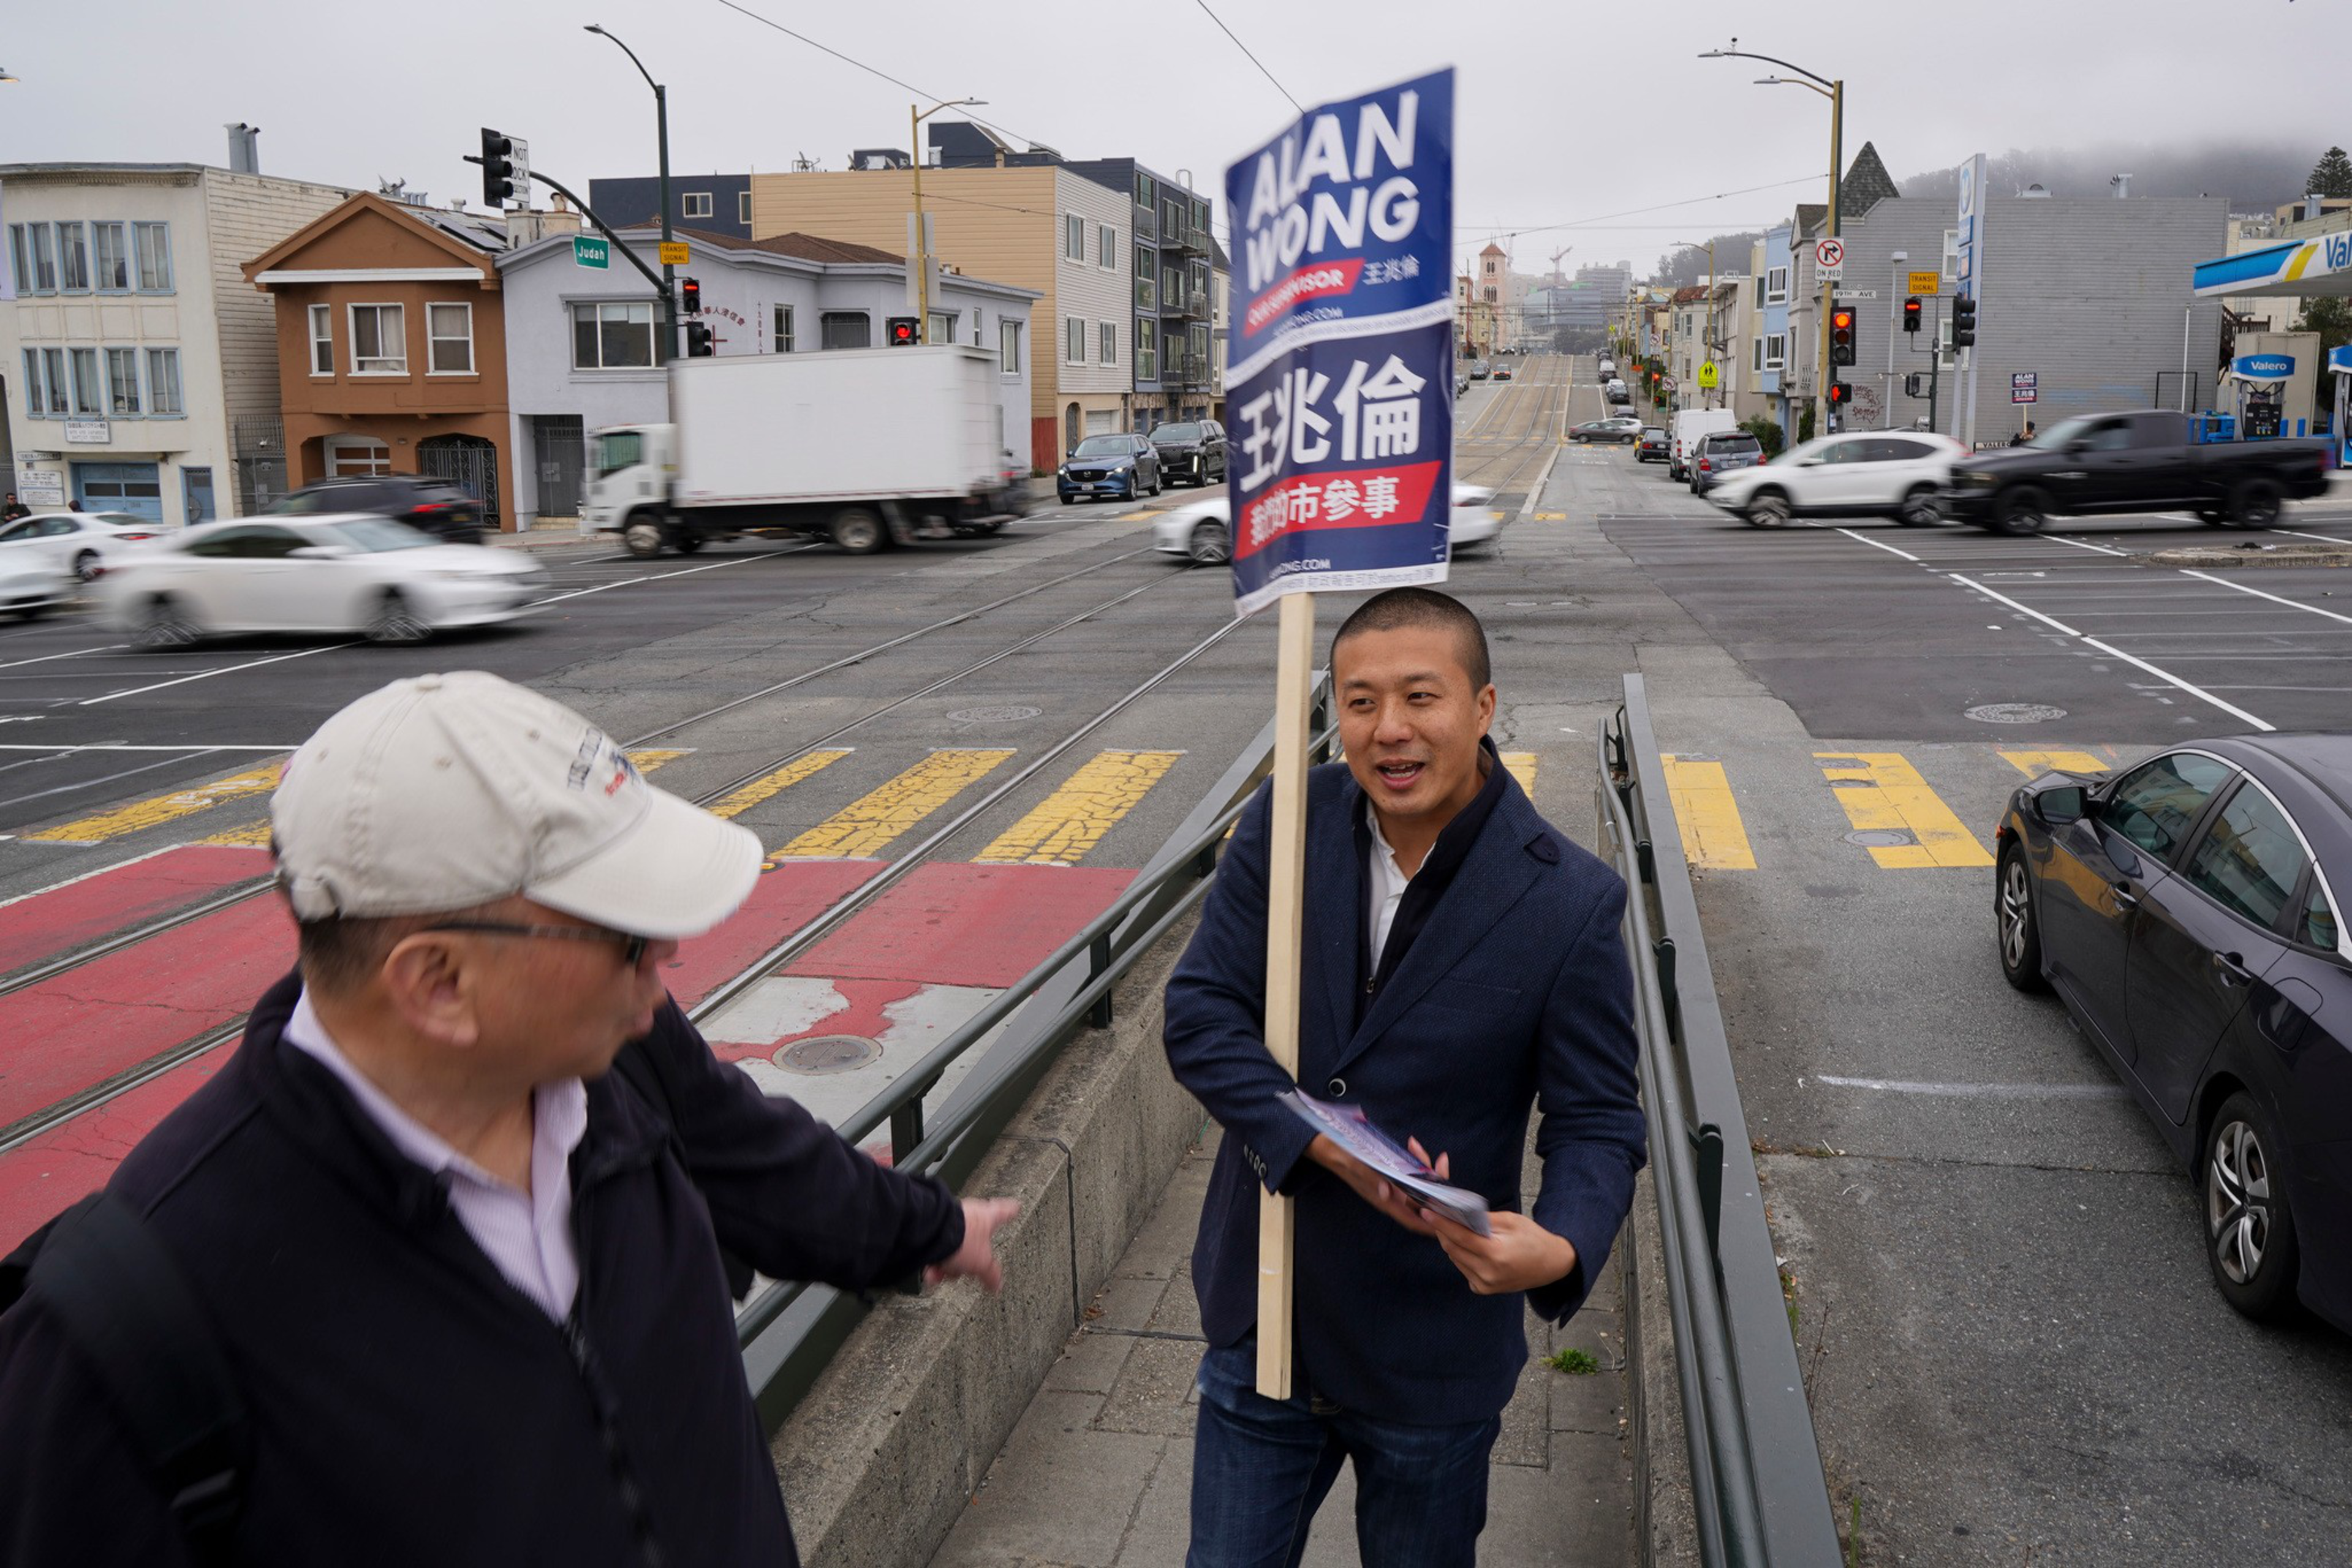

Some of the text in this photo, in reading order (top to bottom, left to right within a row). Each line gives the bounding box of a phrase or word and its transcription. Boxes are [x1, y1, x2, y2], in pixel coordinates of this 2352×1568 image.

[514, 146, 526, 161] NOT
[1246, 89, 1420, 233] ALAN
[512, 166, 527, 181] OCK
[1246, 176, 1420, 293] WONG
[578, 246, 605, 260] Judah
[2326, 233, 2352, 269] Val
[2251, 361, 2287, 370] Valero
